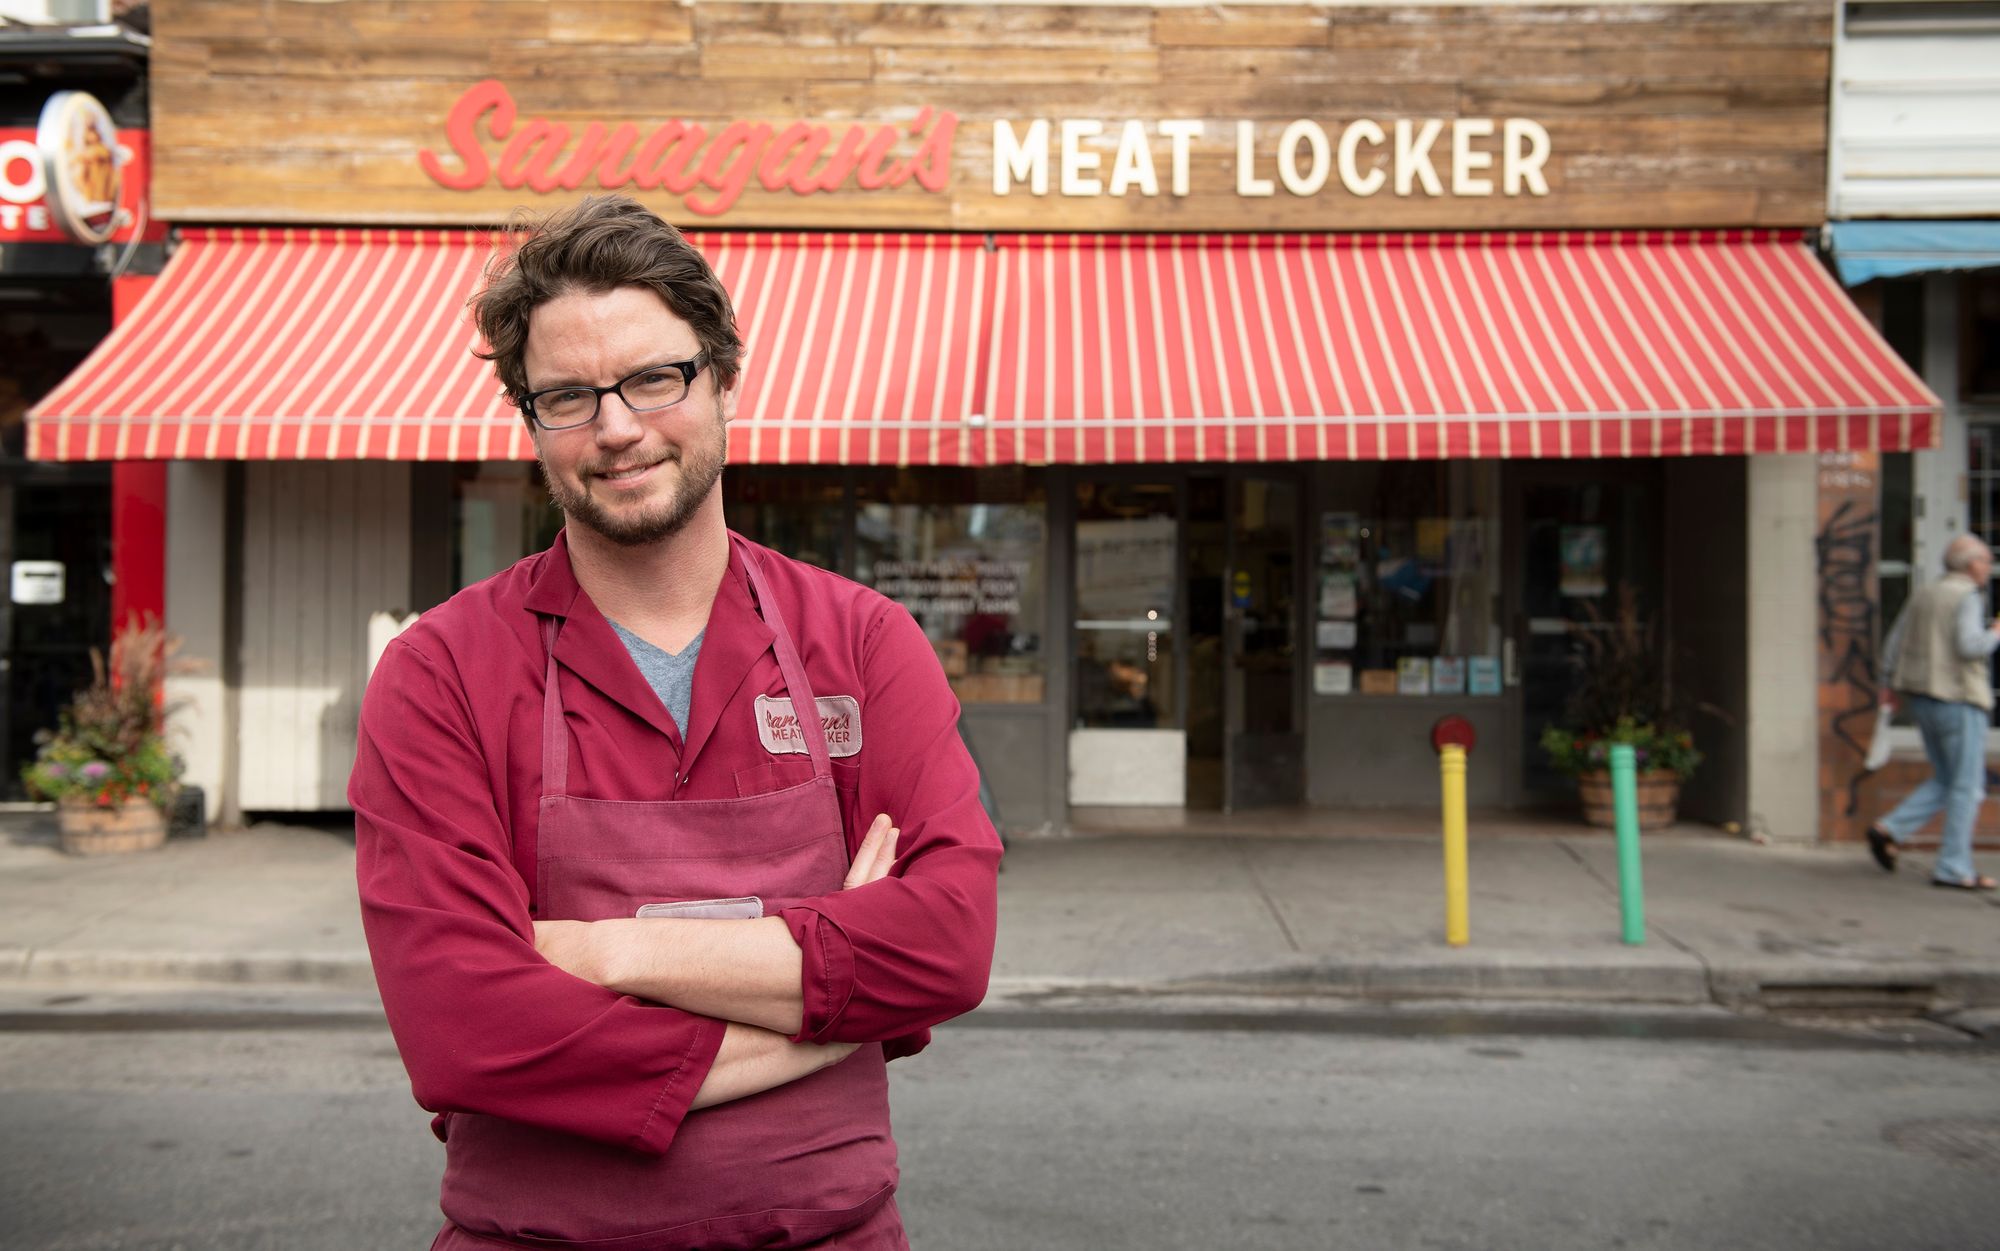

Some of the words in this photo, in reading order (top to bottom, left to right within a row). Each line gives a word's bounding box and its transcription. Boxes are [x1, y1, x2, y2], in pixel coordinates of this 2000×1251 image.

[418, 79, 958, 215] Sanagan's
[992, 119, 1202, 196] MEAT
[1236, 118, 1551, 196] LOCKER
